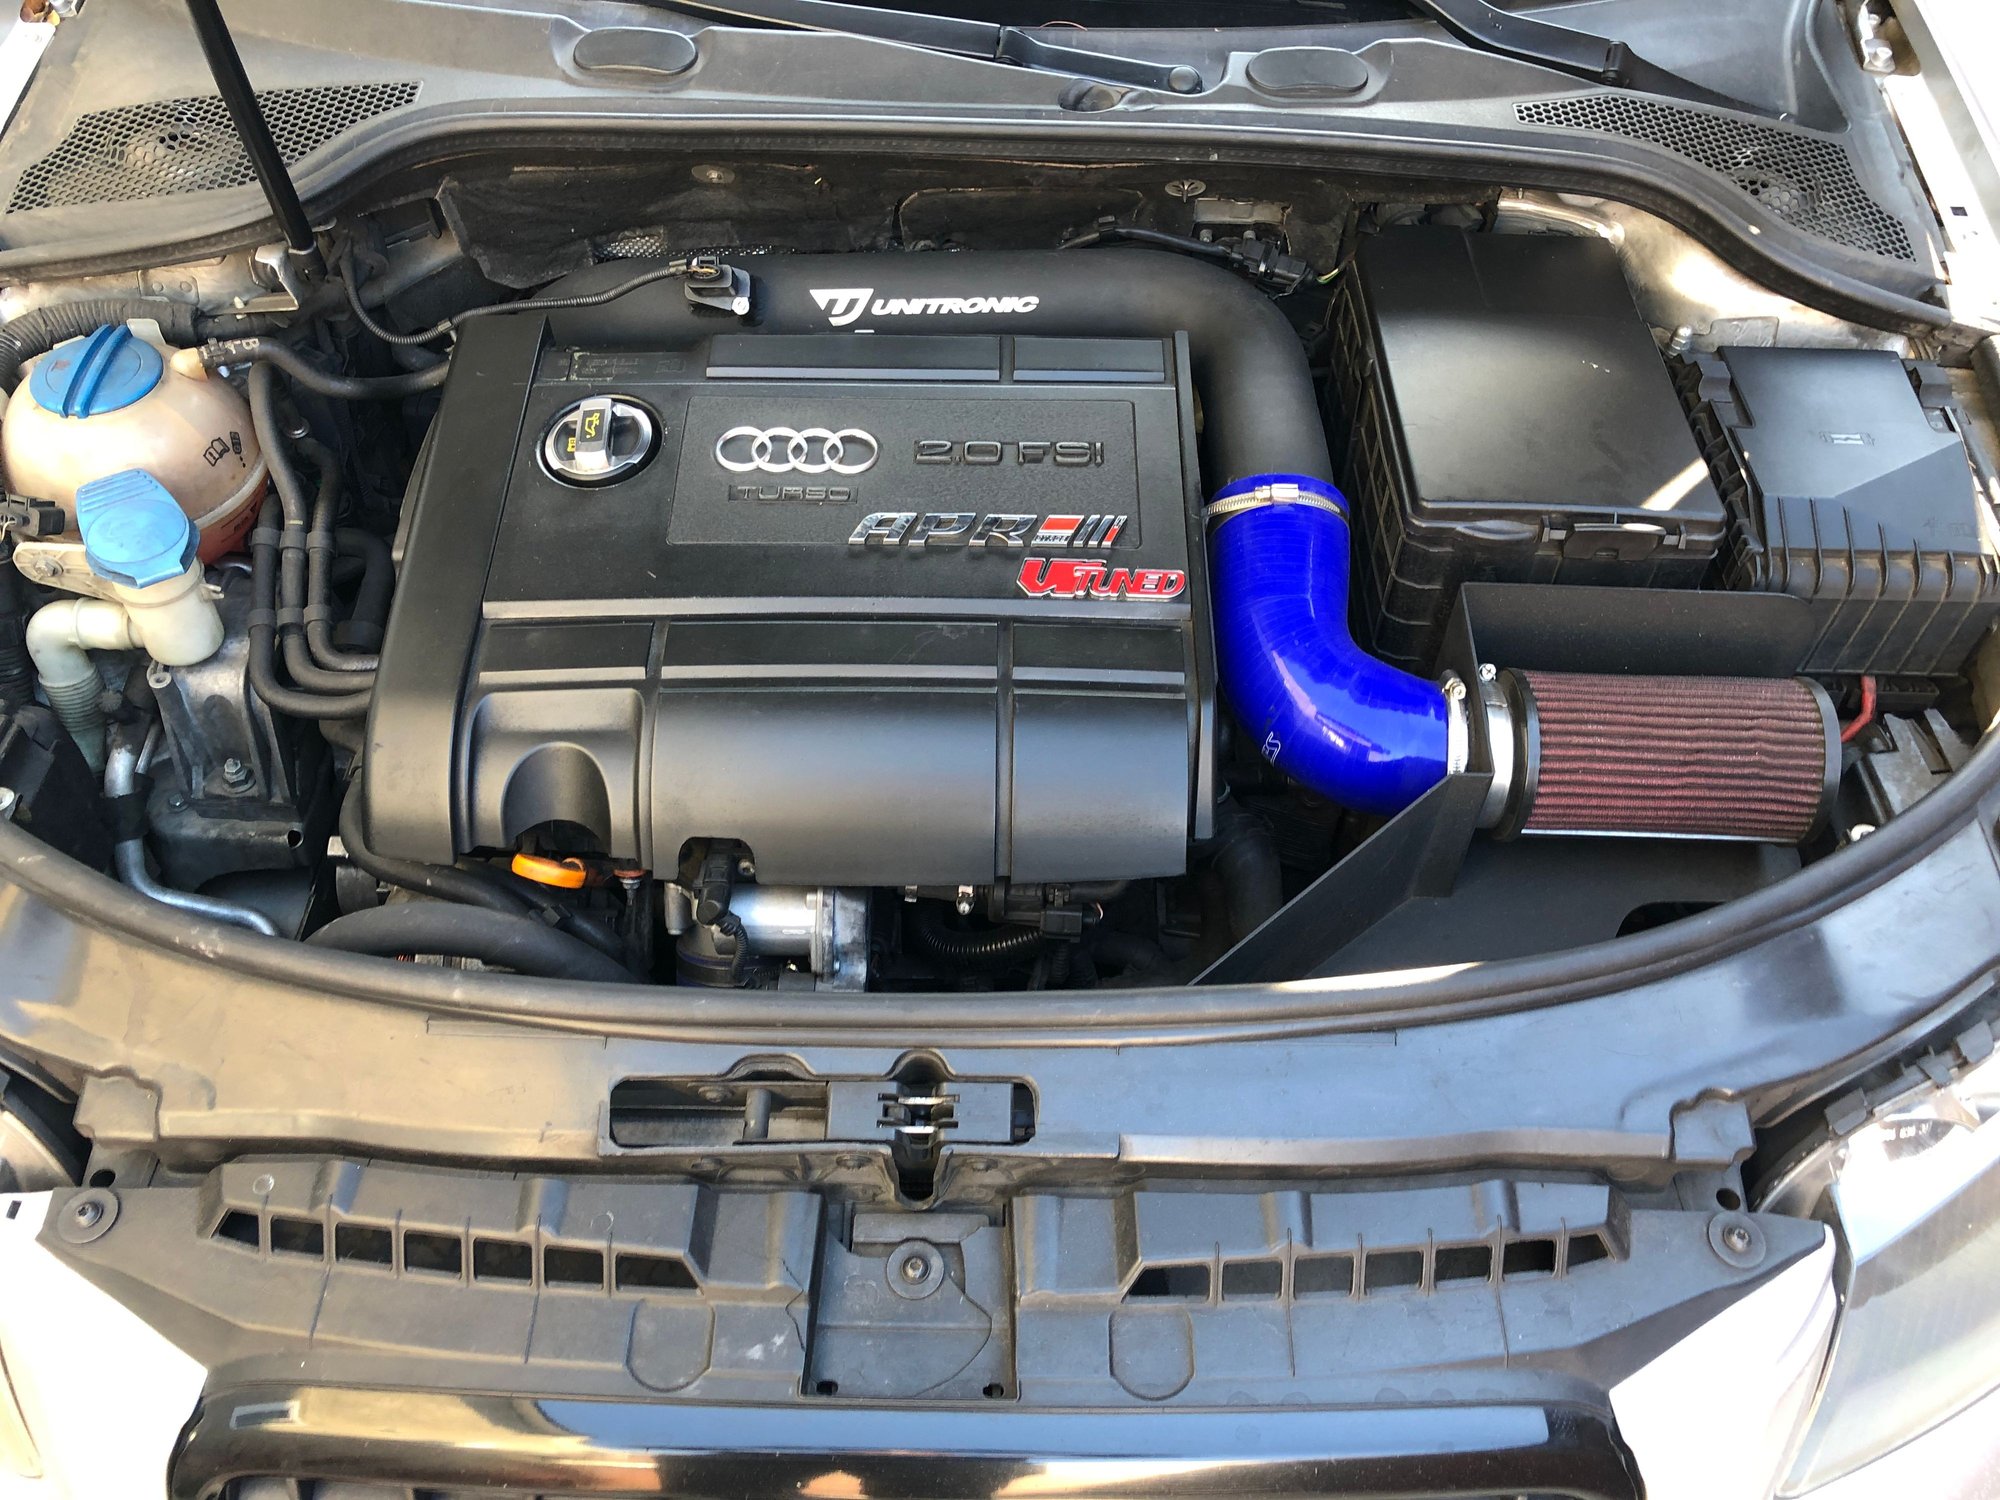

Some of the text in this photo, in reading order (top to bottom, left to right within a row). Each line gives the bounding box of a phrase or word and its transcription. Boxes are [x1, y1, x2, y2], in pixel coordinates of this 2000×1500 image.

[871, 296, 1040, 316] UNITRONIC
[915, 440, 1104, 467] 2.0 FSI
[737, 485, 852, 501] TURBO
[848, 512, 1038, 547] APR
